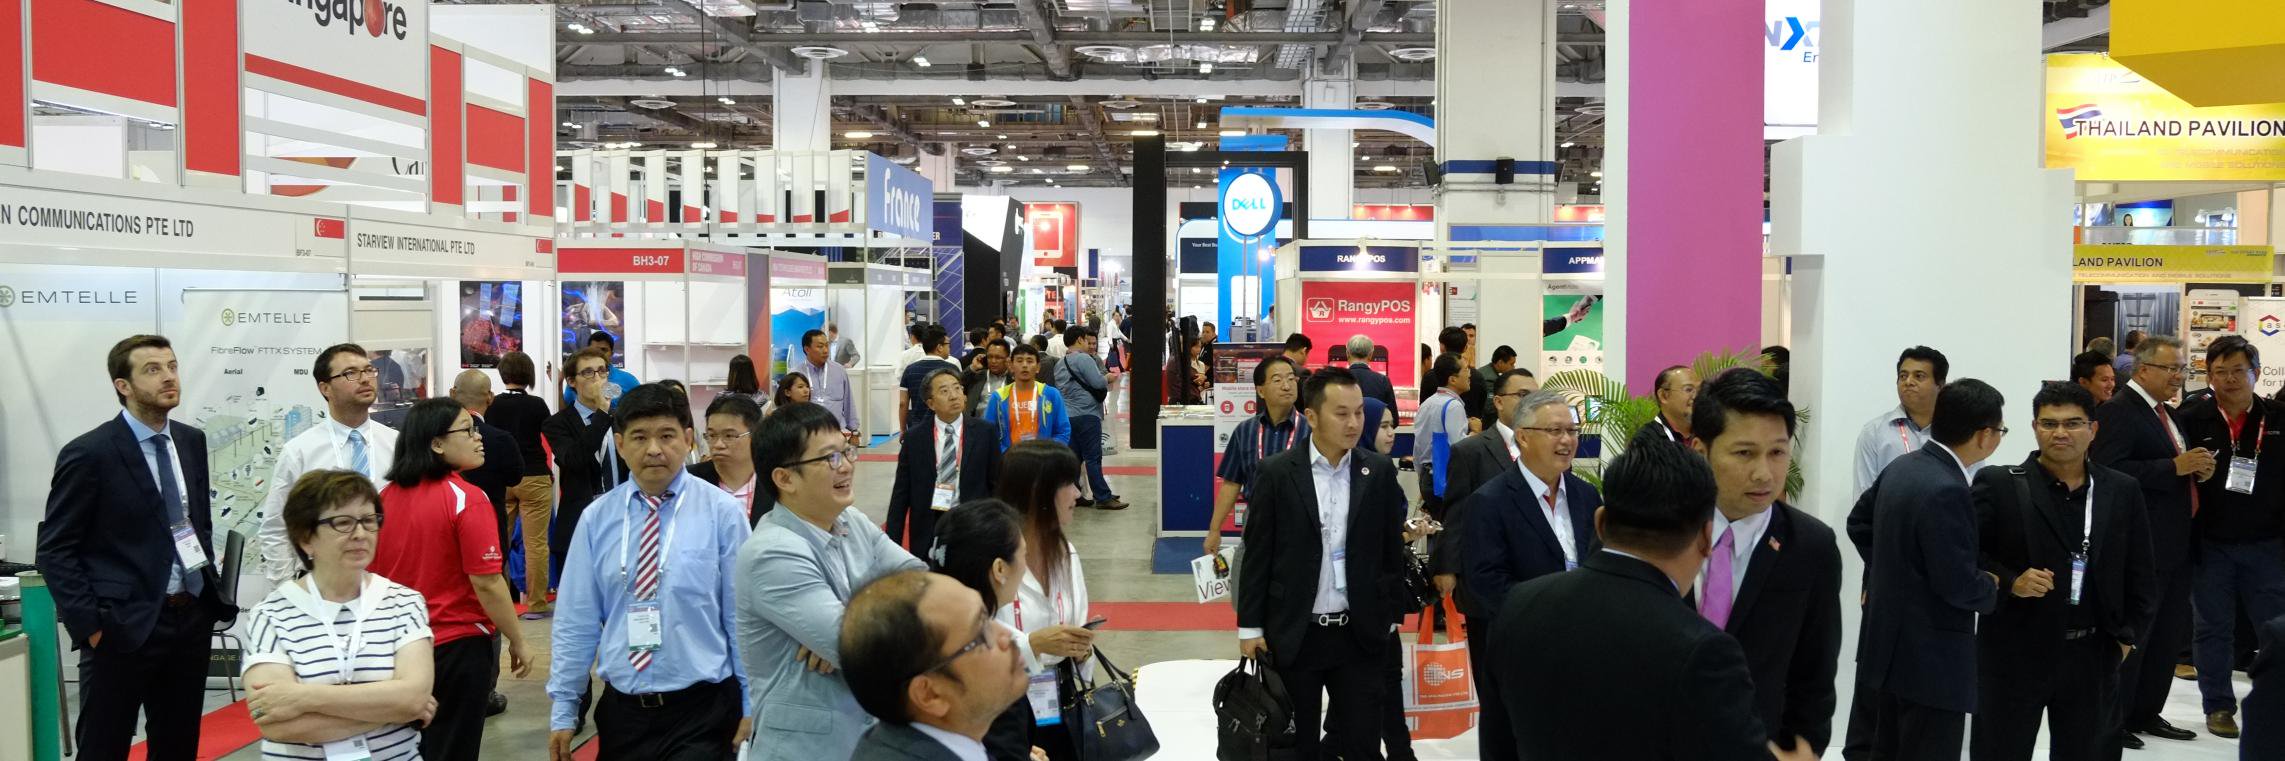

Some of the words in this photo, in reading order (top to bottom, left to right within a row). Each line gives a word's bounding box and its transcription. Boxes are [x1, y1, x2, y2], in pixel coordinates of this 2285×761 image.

[2075, 120, 2182, 136] THAILAND
[2188, 120, 2285, 136] PAVILION
[1232, 198, 1267, 212] DELL
[18, 205, 141, 235] COMMUNICATIONS
[146, 216, 169, 236] PTE
[173, 219, 194, 238] LTD
[357, 232, 394, 250] STARVIEW
[397, 235, 449, 254] INTERNATIONAL
[450, 240, 462, 255] PTE
[463, 242, 475, 255] LTD
[633, 255, 670, 266] BH3-07
[2107, 257, 2163, 267] PAVILION
[22, 291, 137, 303] EMTELLE
[1338, 300, 1411, 314] RangyPOS
[238, 313, 311, 324] EMTELLE
[1338, 317, 1411, 325] www.rangypos.com
[211, 346, 254, 355] FibreFlow
[2263, 379, 2276, 387] for
